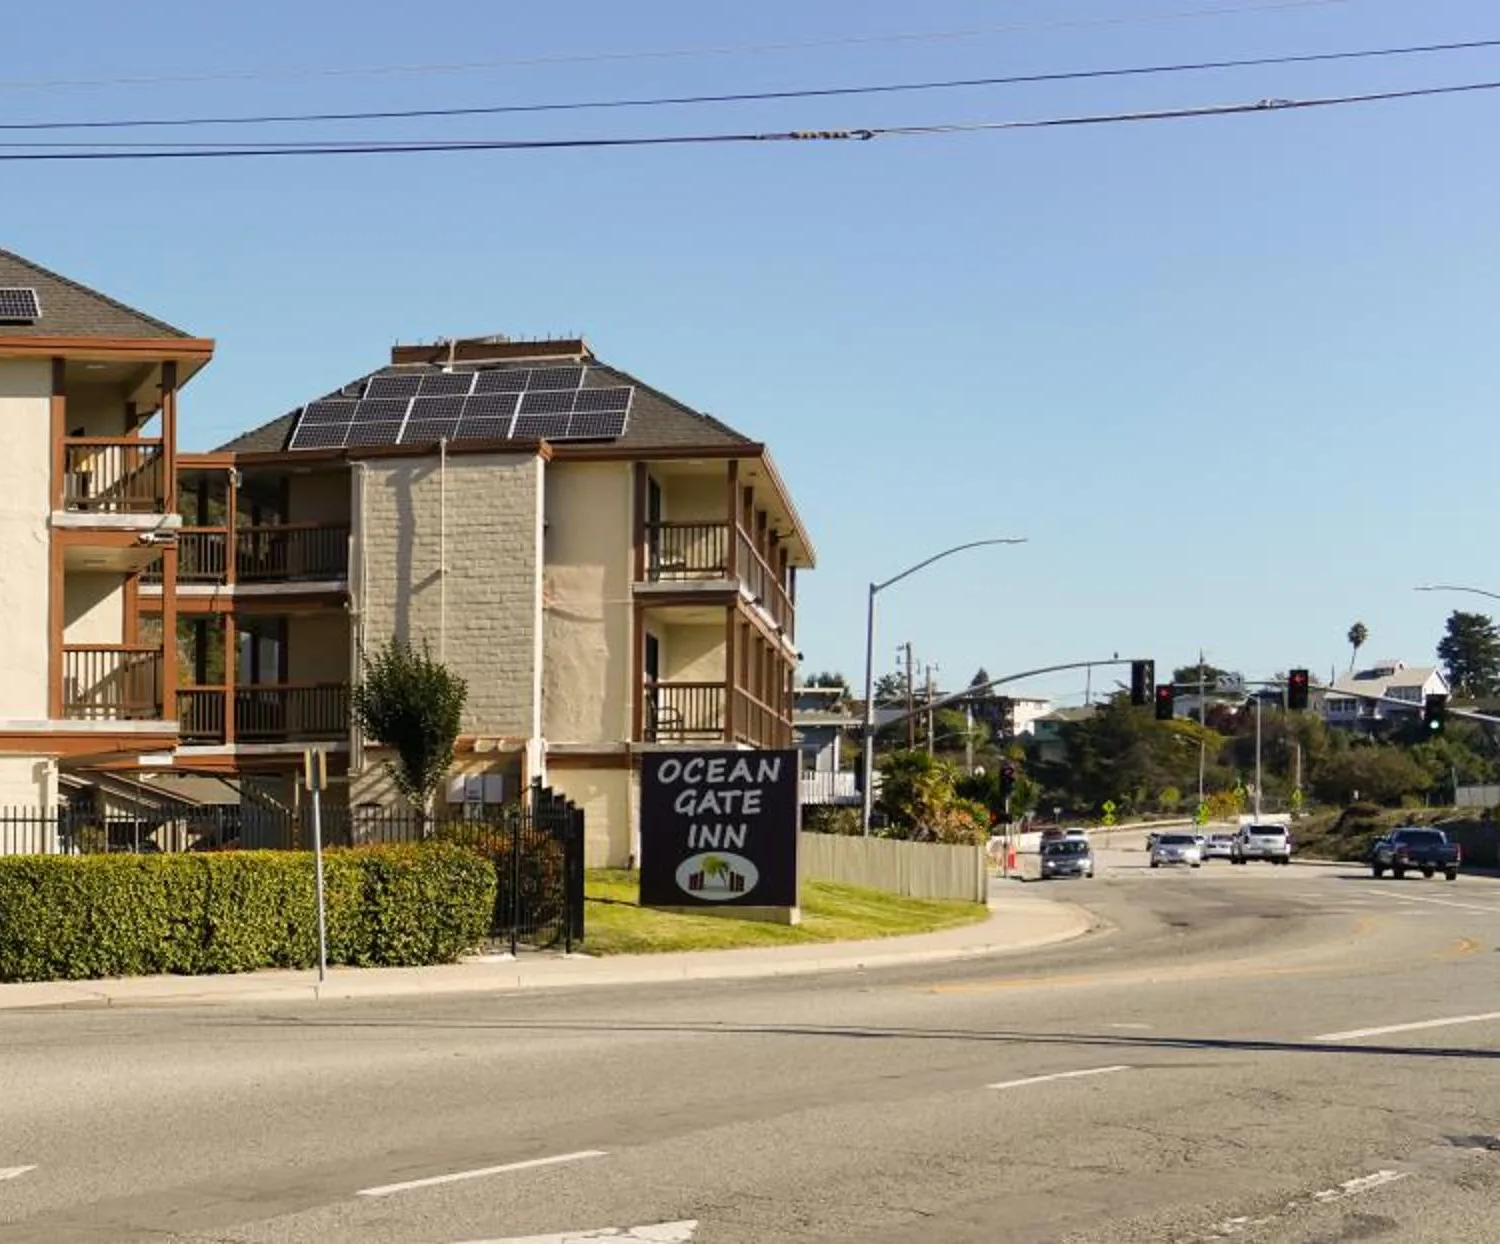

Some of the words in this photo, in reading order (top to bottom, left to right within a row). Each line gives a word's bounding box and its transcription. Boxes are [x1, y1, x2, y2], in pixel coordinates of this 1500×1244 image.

[657, 757, 781, 784] OCEAN
[674, 789, 763, 815] GATE
[687, 823, 747, 848] INN
